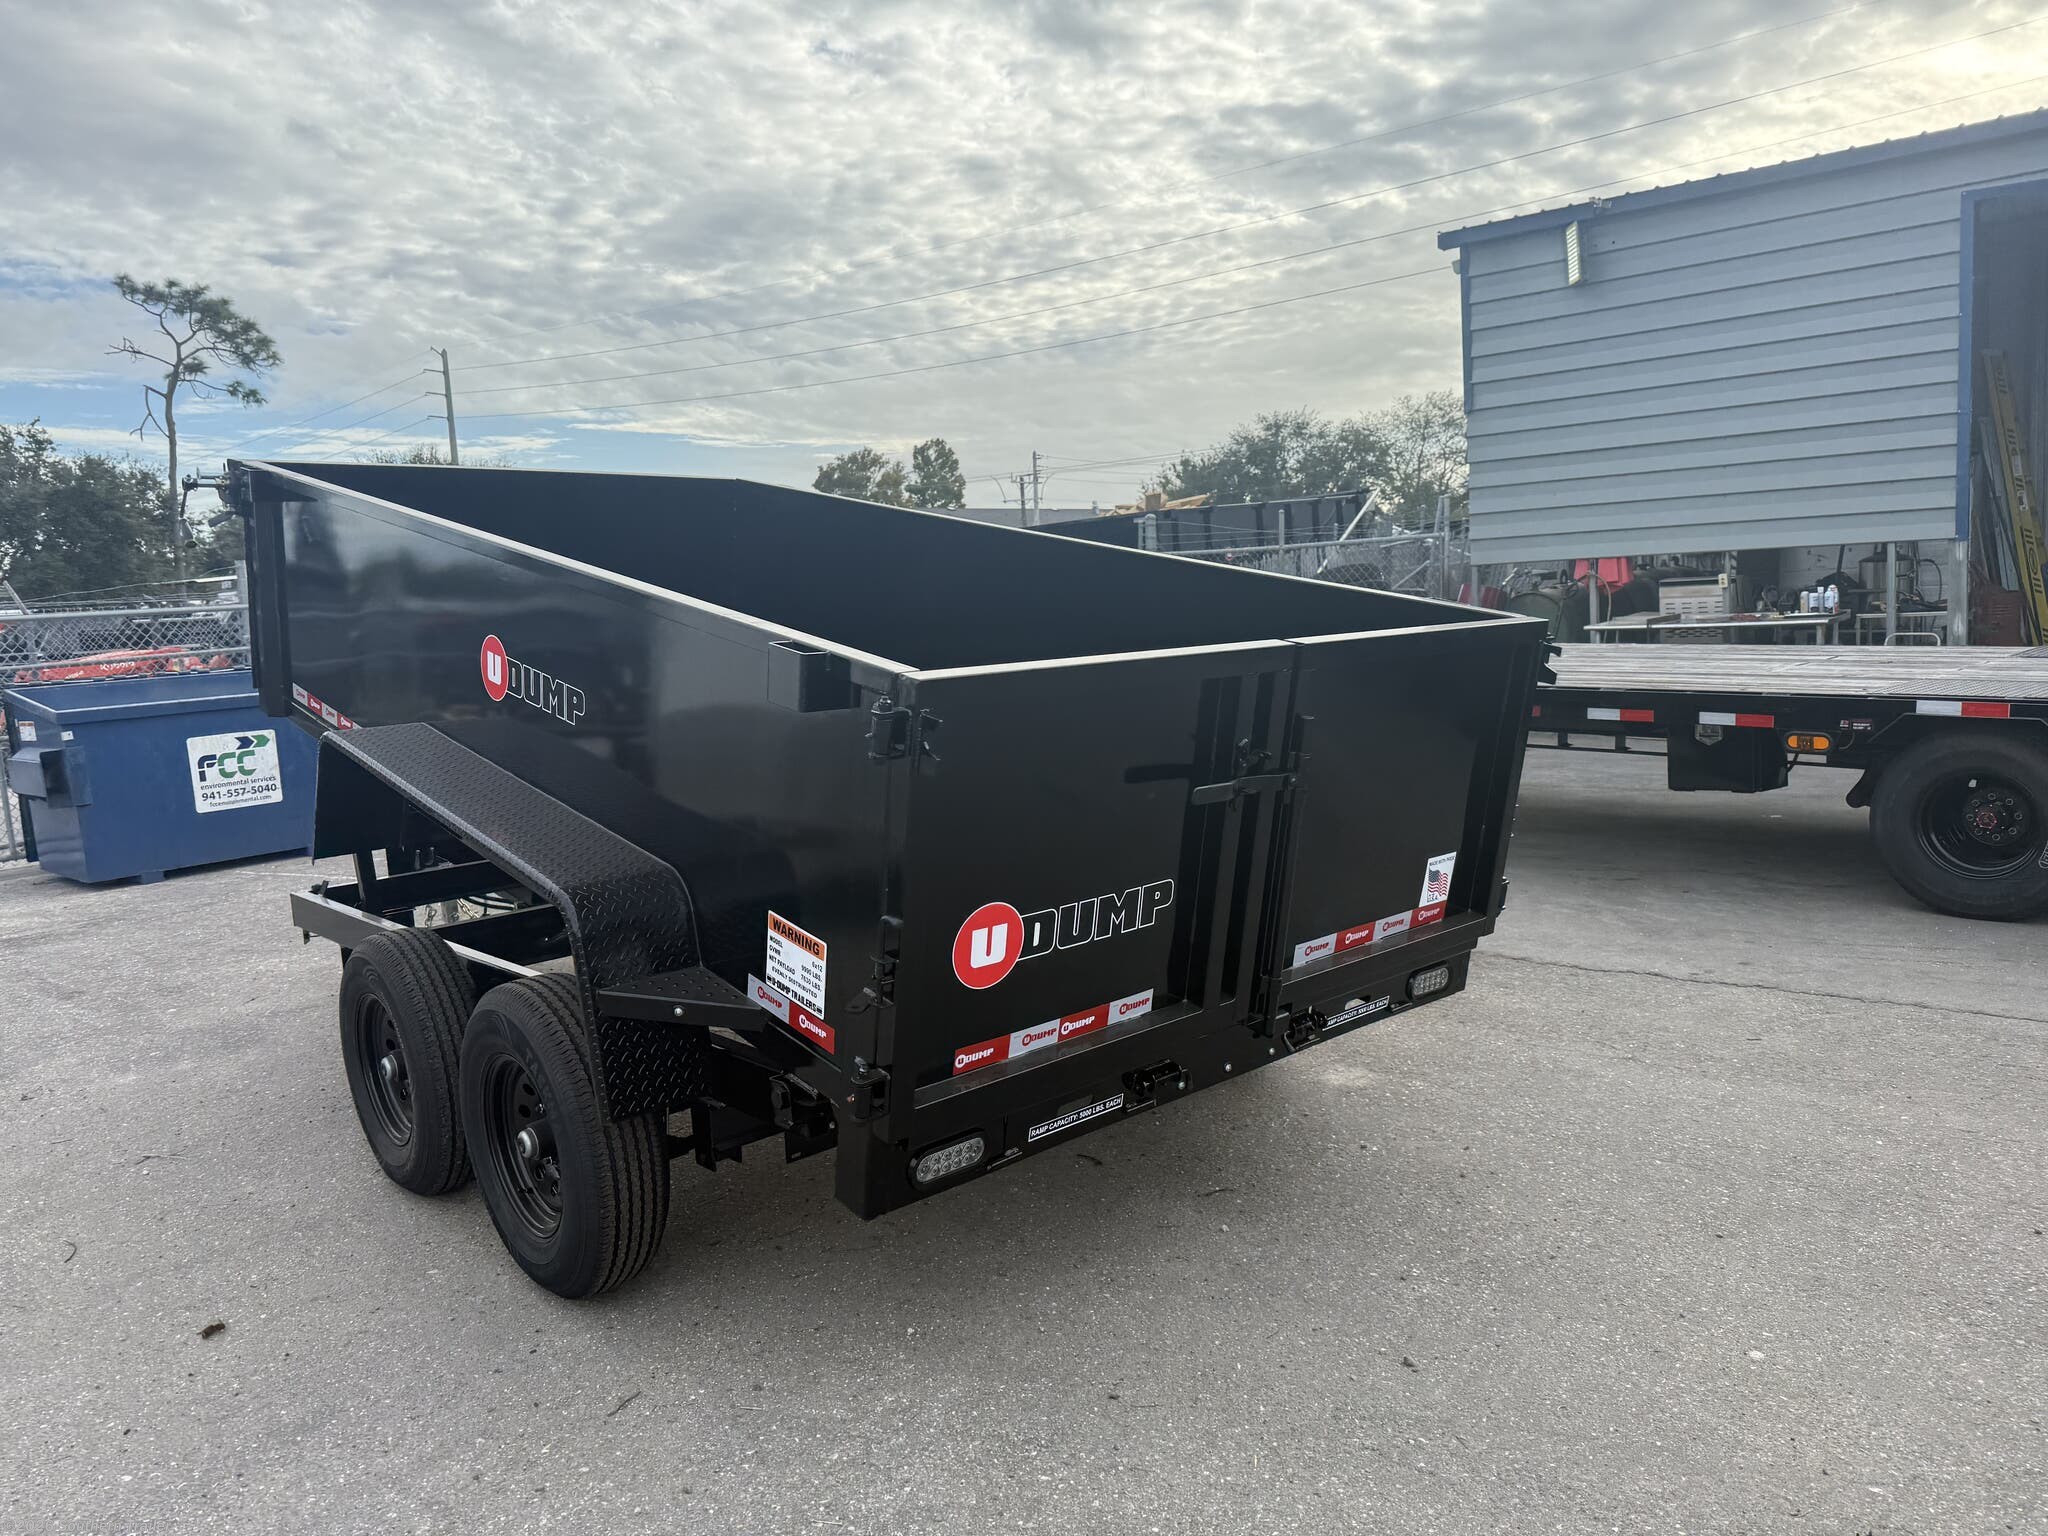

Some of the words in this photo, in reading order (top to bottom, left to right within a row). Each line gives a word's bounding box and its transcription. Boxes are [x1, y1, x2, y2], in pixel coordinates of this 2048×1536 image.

[197, 749, 257, 782] FCC
[200, 776, 249, 790] environmental
[250, 775, 276, 785] services
[202, 783, 277, 801] 941-557-5040
[772, 917, 820, 956] WARNING
[791, 989, 817, 1012] TRAILERS
[1031, 1125, 1048, 1137] RAMP
[1106, 1097, 1121, 1110] EACH
